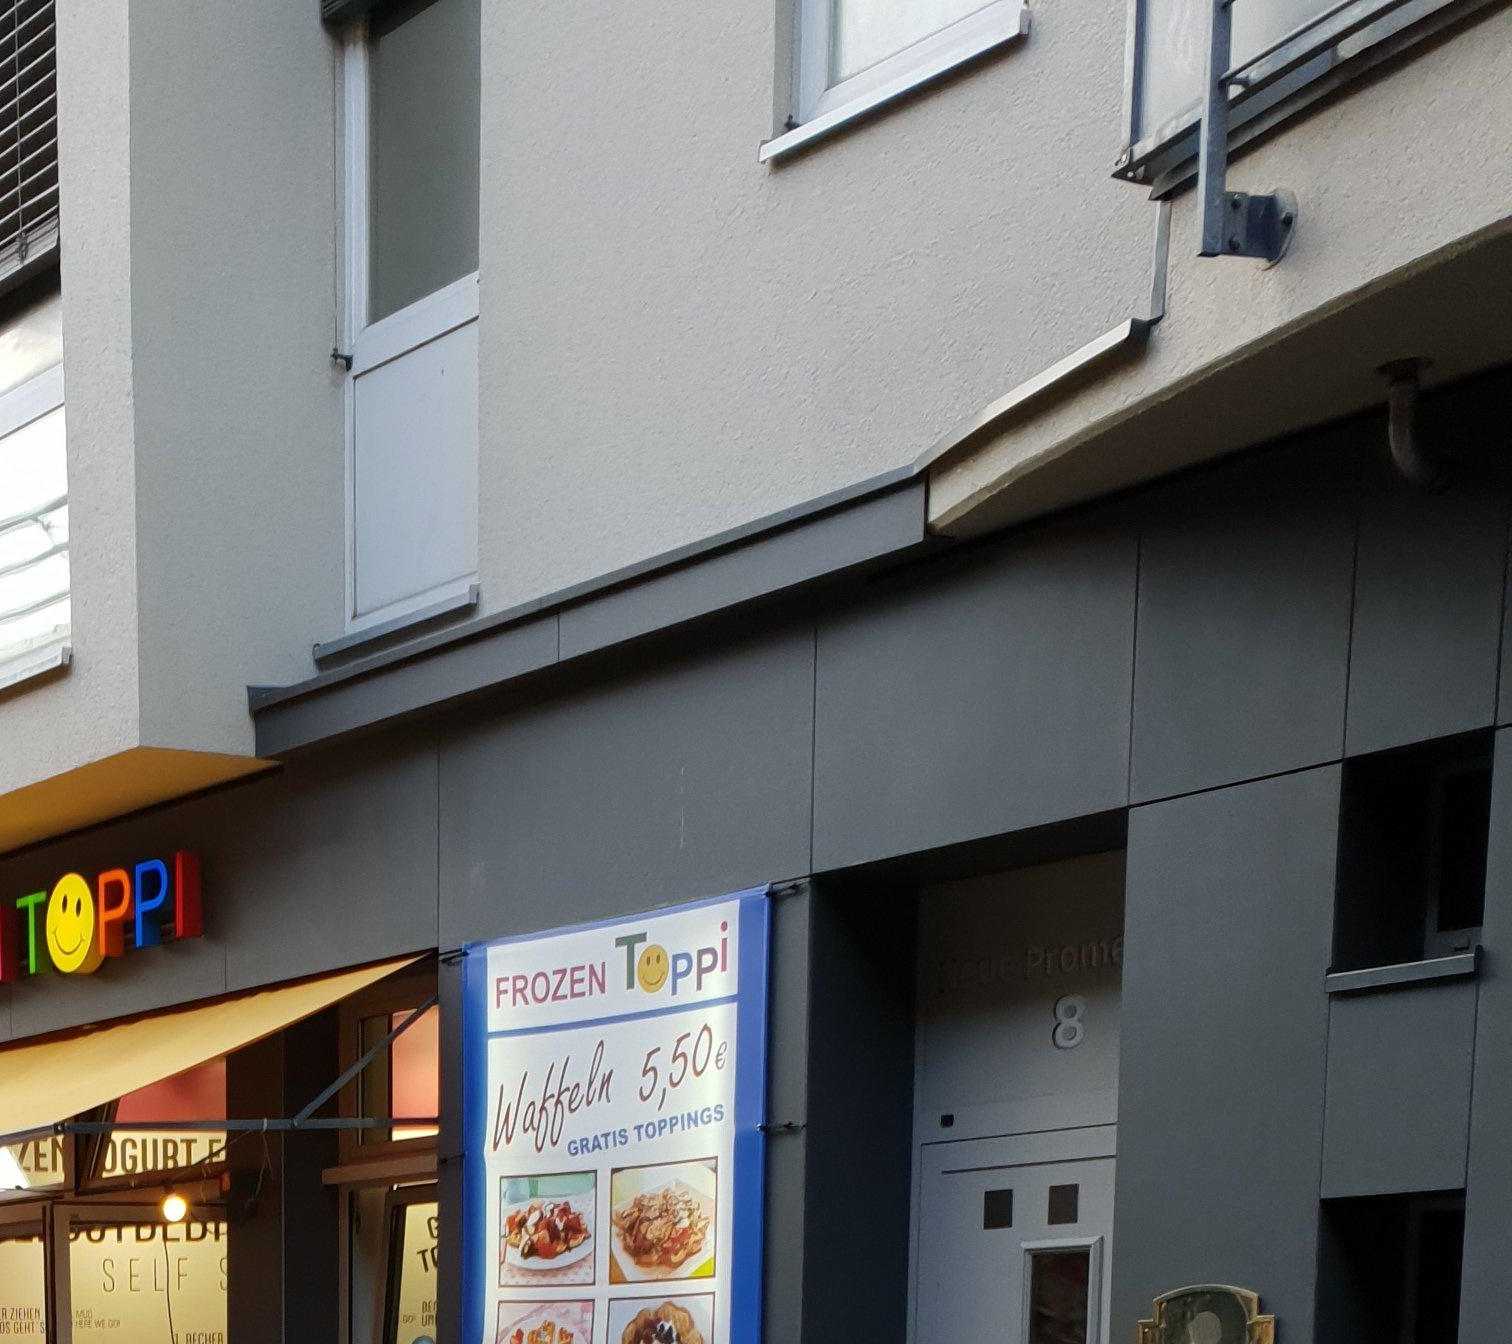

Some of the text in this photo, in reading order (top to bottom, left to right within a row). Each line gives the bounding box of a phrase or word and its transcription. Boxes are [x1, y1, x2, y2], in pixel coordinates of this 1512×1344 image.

[495, 961, 607, 1009] FROZEN
[1052, 994, 1086, 1049] 8
[492, 1040, 611, 1153] Waffeln
[567, 1104, 725, 1157] GRATIS TOPPINGS
[103, 1138, 197, 1174] OGURT
[102, 1258, 188, 1292] SELF
[9, 1308, 40, 1320] ZIEHEN
